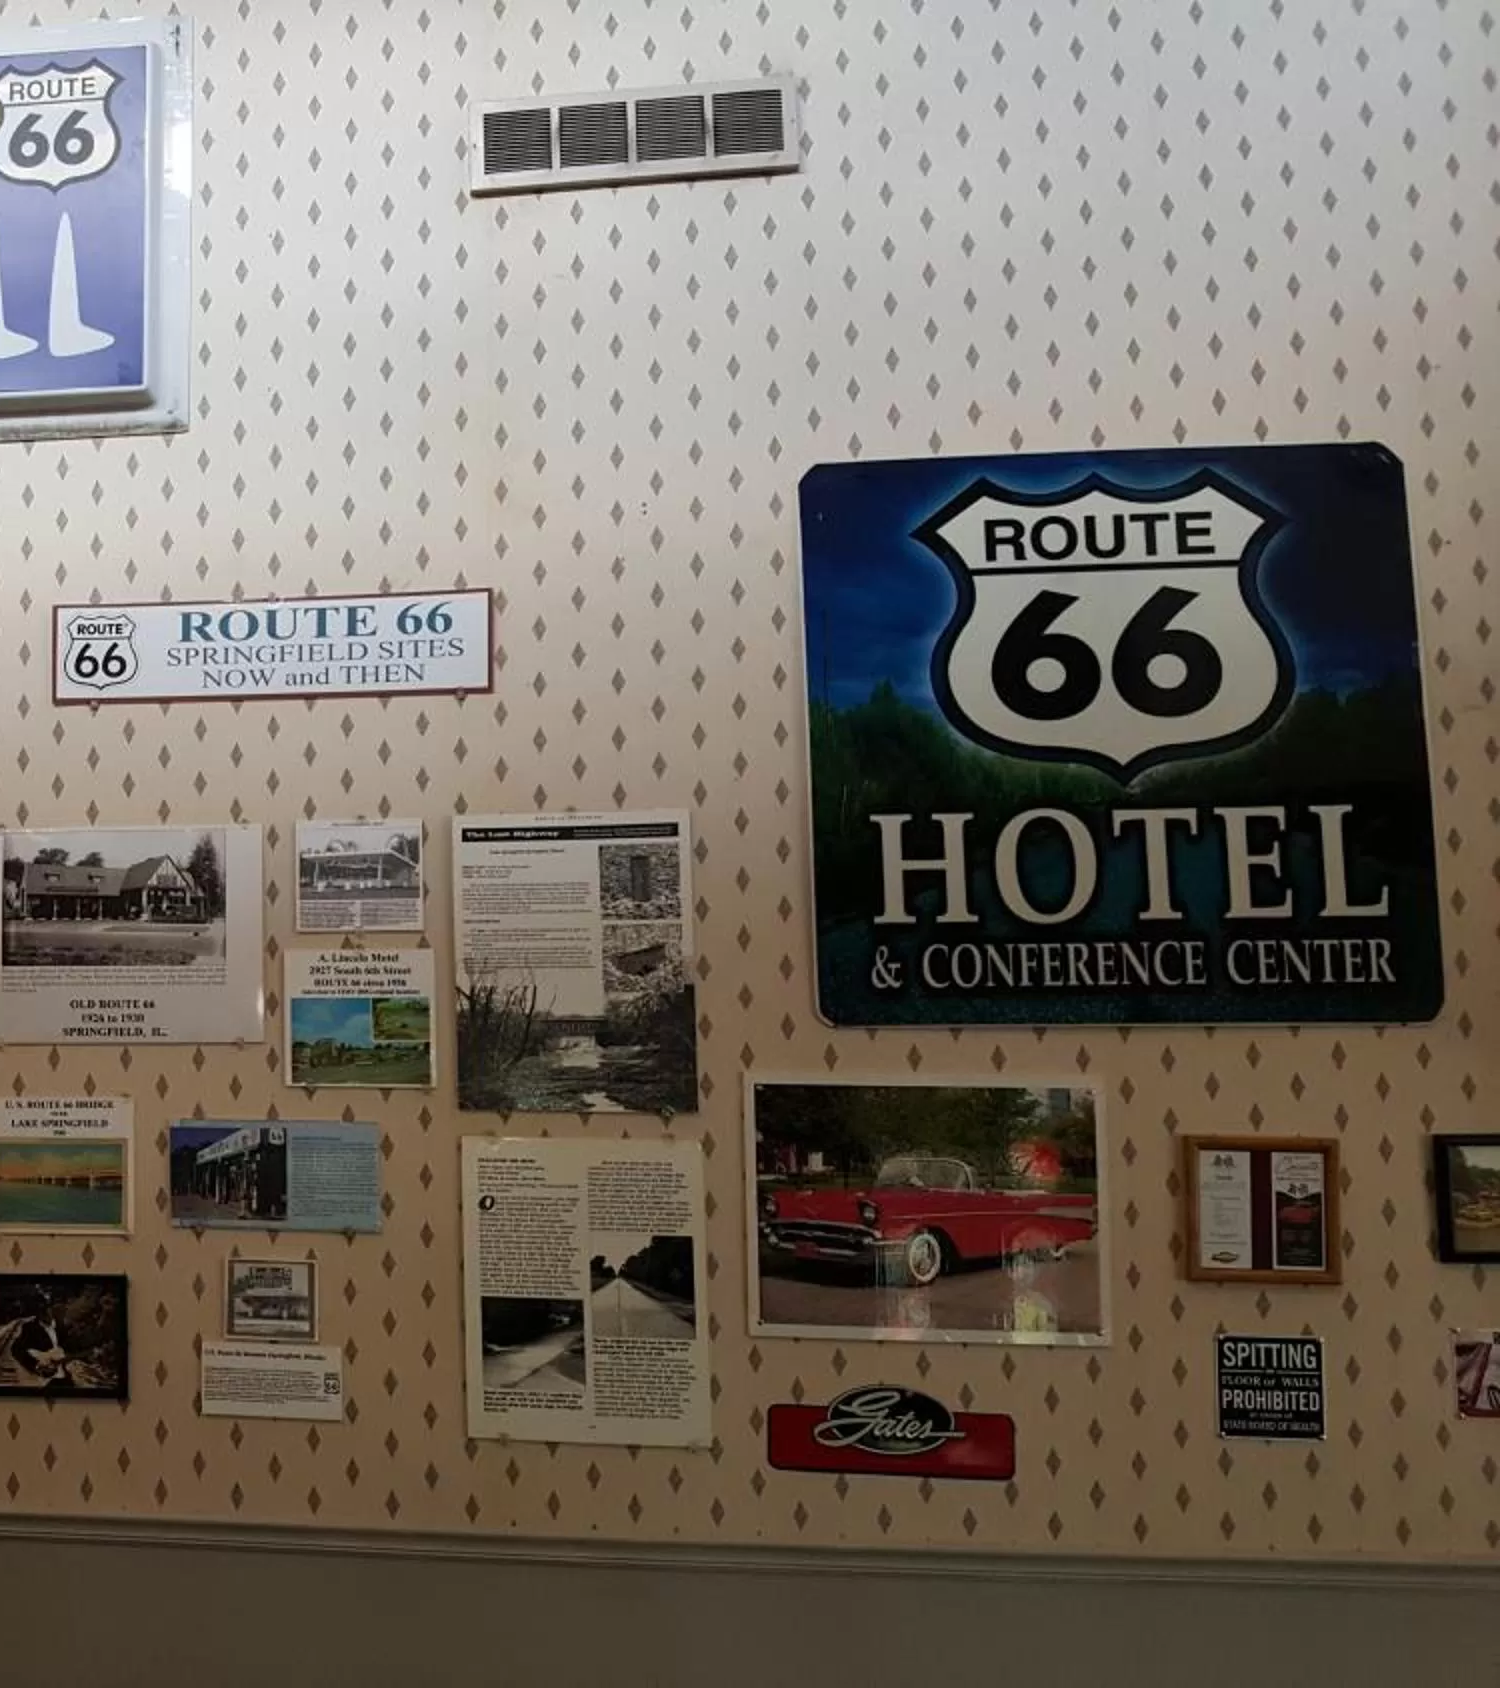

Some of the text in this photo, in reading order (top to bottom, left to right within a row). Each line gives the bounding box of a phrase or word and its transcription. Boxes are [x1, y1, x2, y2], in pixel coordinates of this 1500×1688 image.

[9, 75, 96, 103] ROUTE
[7, 108, 97, 166] 66
[984, 511, 1216, 562] ROUTE
[77, 622, 123, 637] ROUTE
[179, 601, 453, 643] ROUTE 66
[73, 642, 127, 679] 66
[167, 637, 465, 667] SPRINGFIELD SITES
[991, 585, 1223, 721] 66
[201, 663, 426, 689] NOW and THEN
[869, 803, 1389, 926] HOTEL
[383, 966, 412, 975] Street
[871, 938, 1397, 989] & CONFERENCE CENTER
[69, 999, 155, 1009] OLD ROUTE 66
[107, 1014, 118, 1023] to
[11, 1119, 109, 1128] LAKE SPRINGFIELD
[1223, 1342, 1317, 1369] SPITTING
[1282, 1377, 1320, 1387] WALLS
[1223, 1389, 1320, 1411] PROHIBITED
[813, 1391, 967, 1447] Gates
